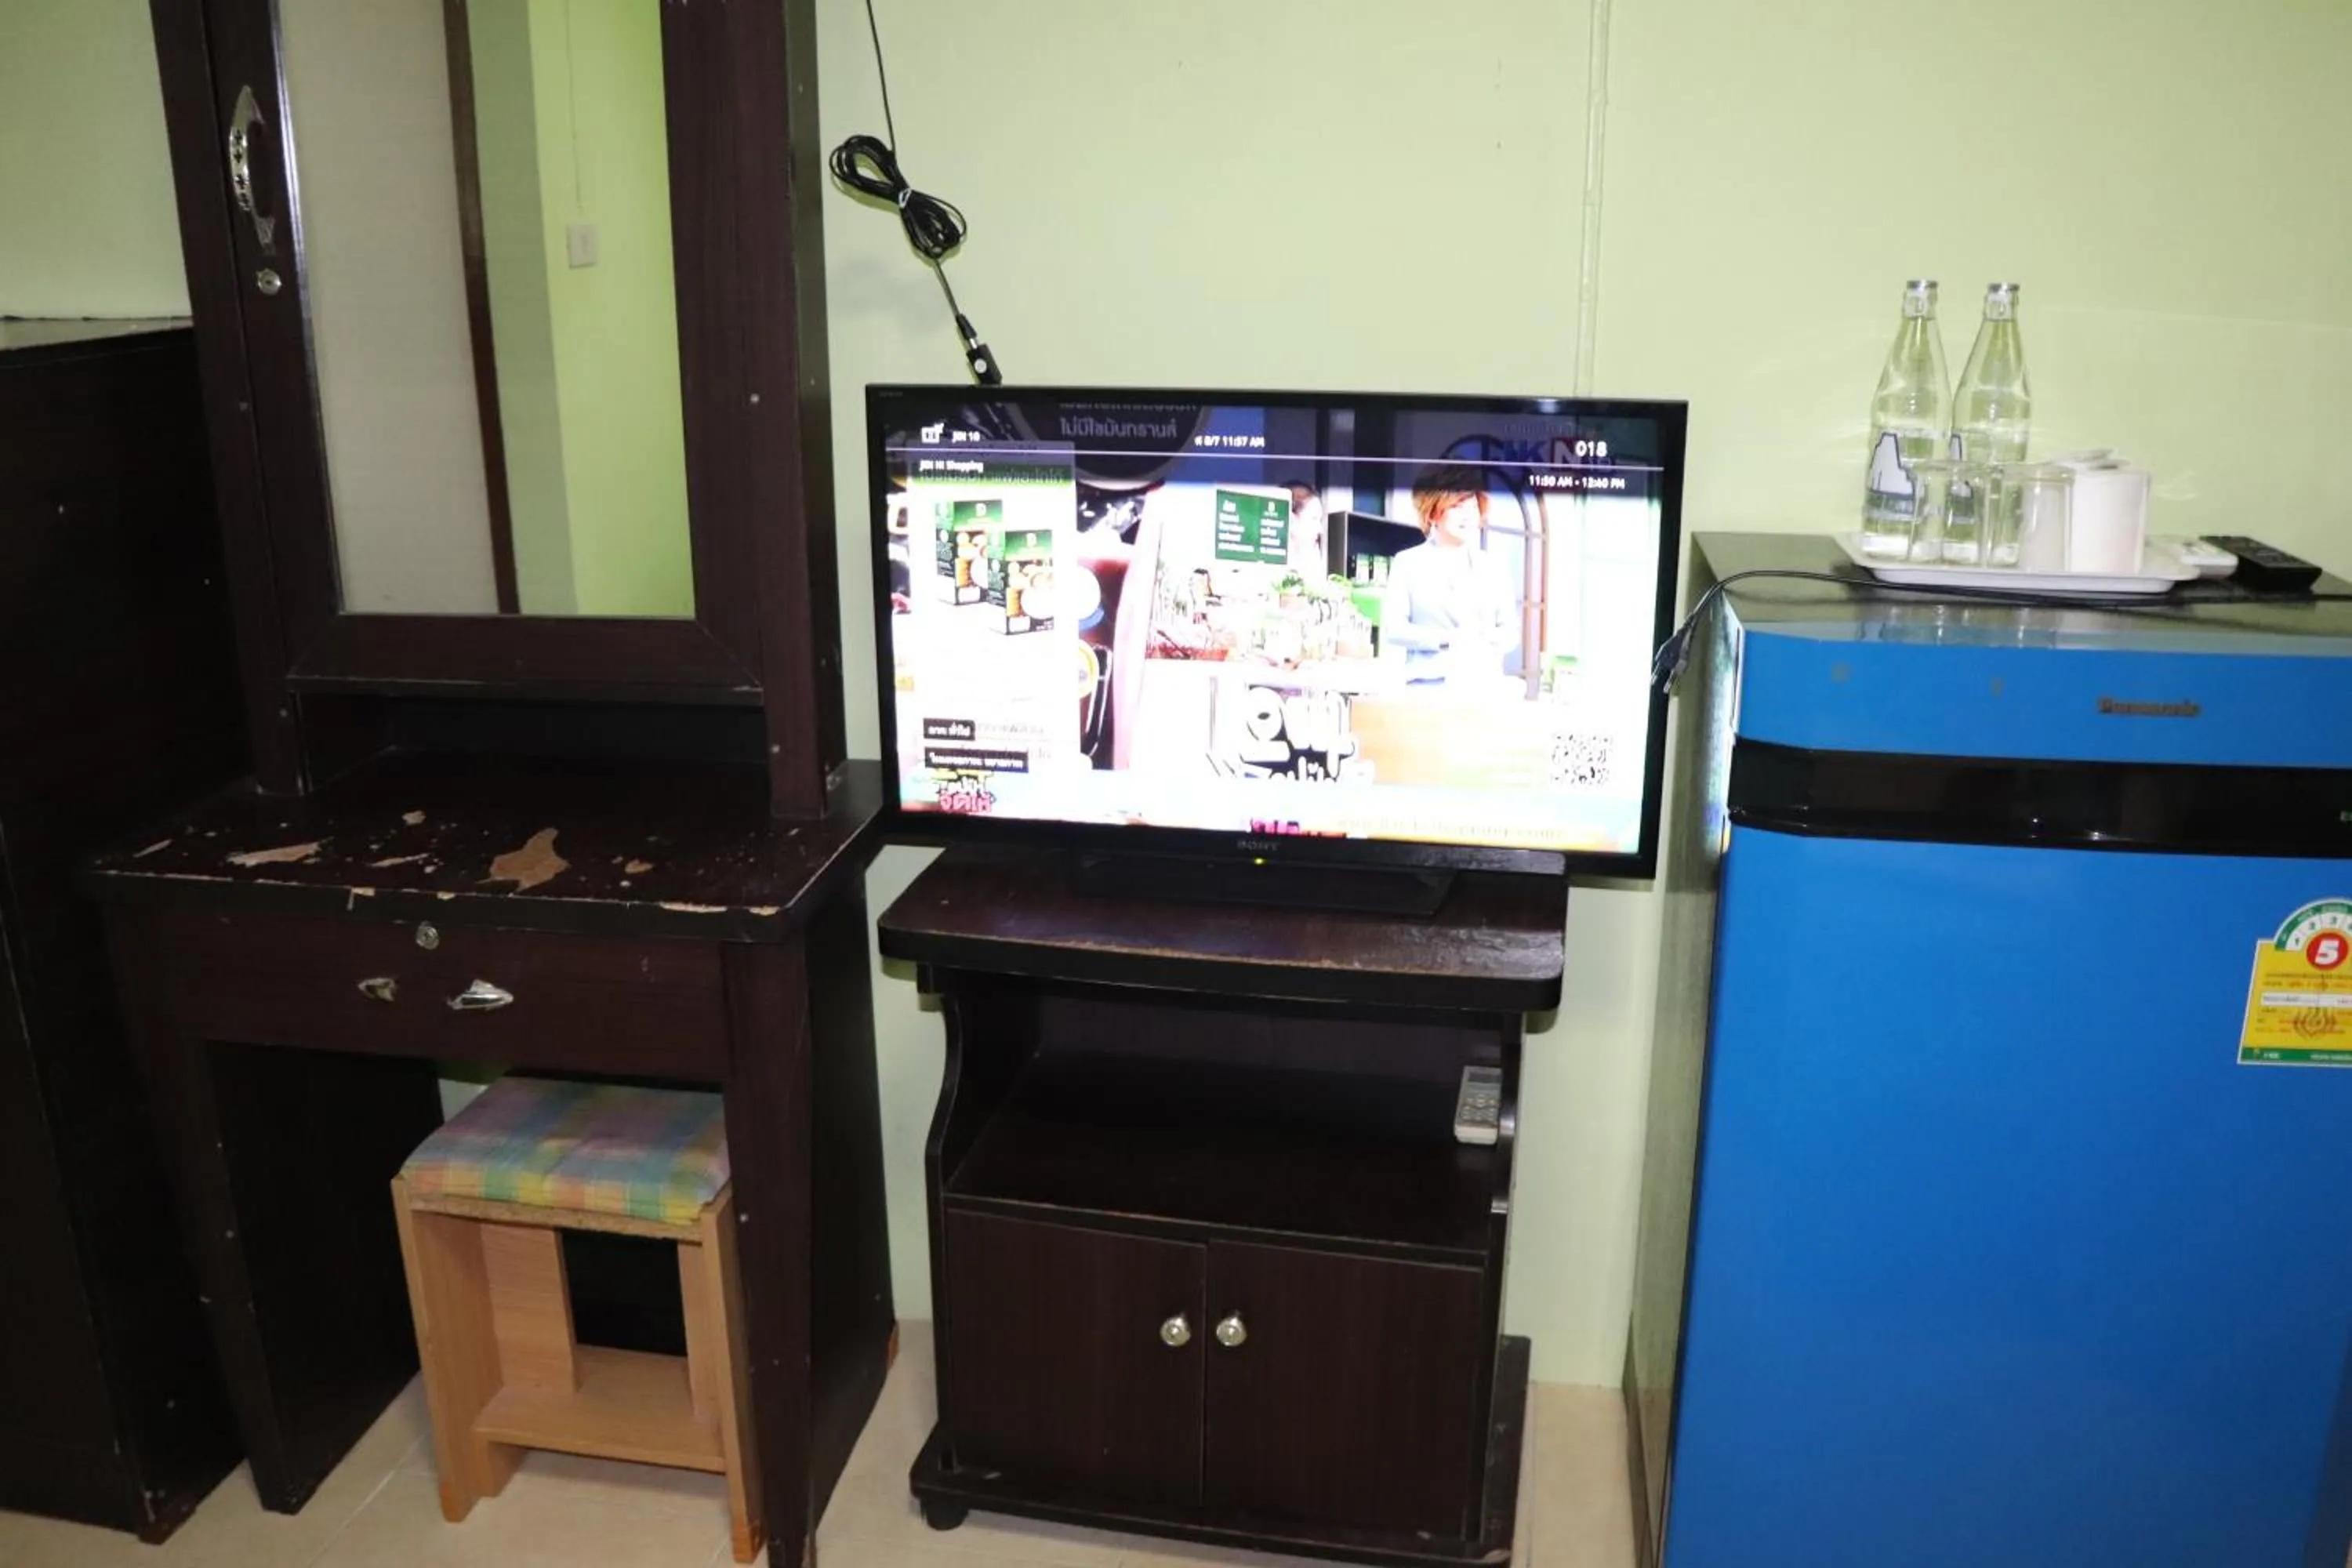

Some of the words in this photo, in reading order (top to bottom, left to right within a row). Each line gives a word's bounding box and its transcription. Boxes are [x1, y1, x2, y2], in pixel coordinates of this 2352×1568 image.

[1249, 436, 1265, 448] AM
[1574, 440, 1607, 458] 018
[1557, 475, 1573, 487] AM
[1610, 478, 1625, 489] PM
[2314, 938, 2340, 966] 5
